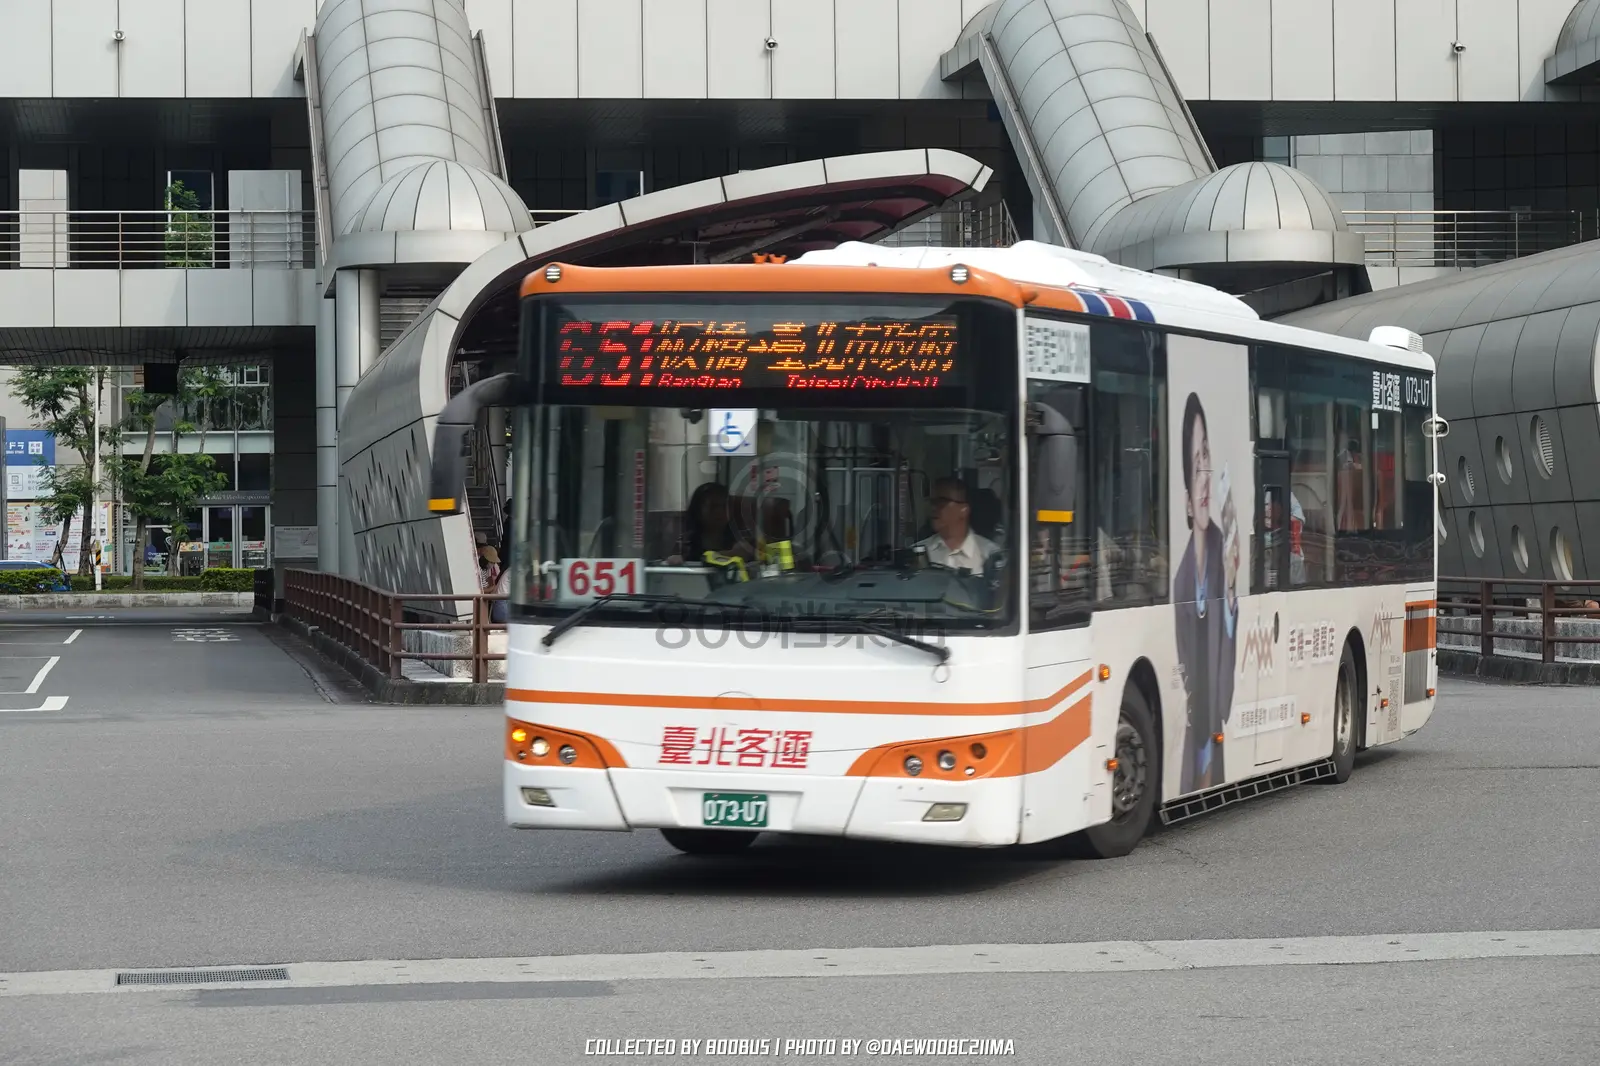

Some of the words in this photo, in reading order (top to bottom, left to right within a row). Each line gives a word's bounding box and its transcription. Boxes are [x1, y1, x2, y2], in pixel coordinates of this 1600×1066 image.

[1405, 376, 1430, 407] 073-U7
[568, 561, 637, 596] 651
[658, 726, 814, 769] 臺北客運
[703, 799, 767, 822] 073-U7
